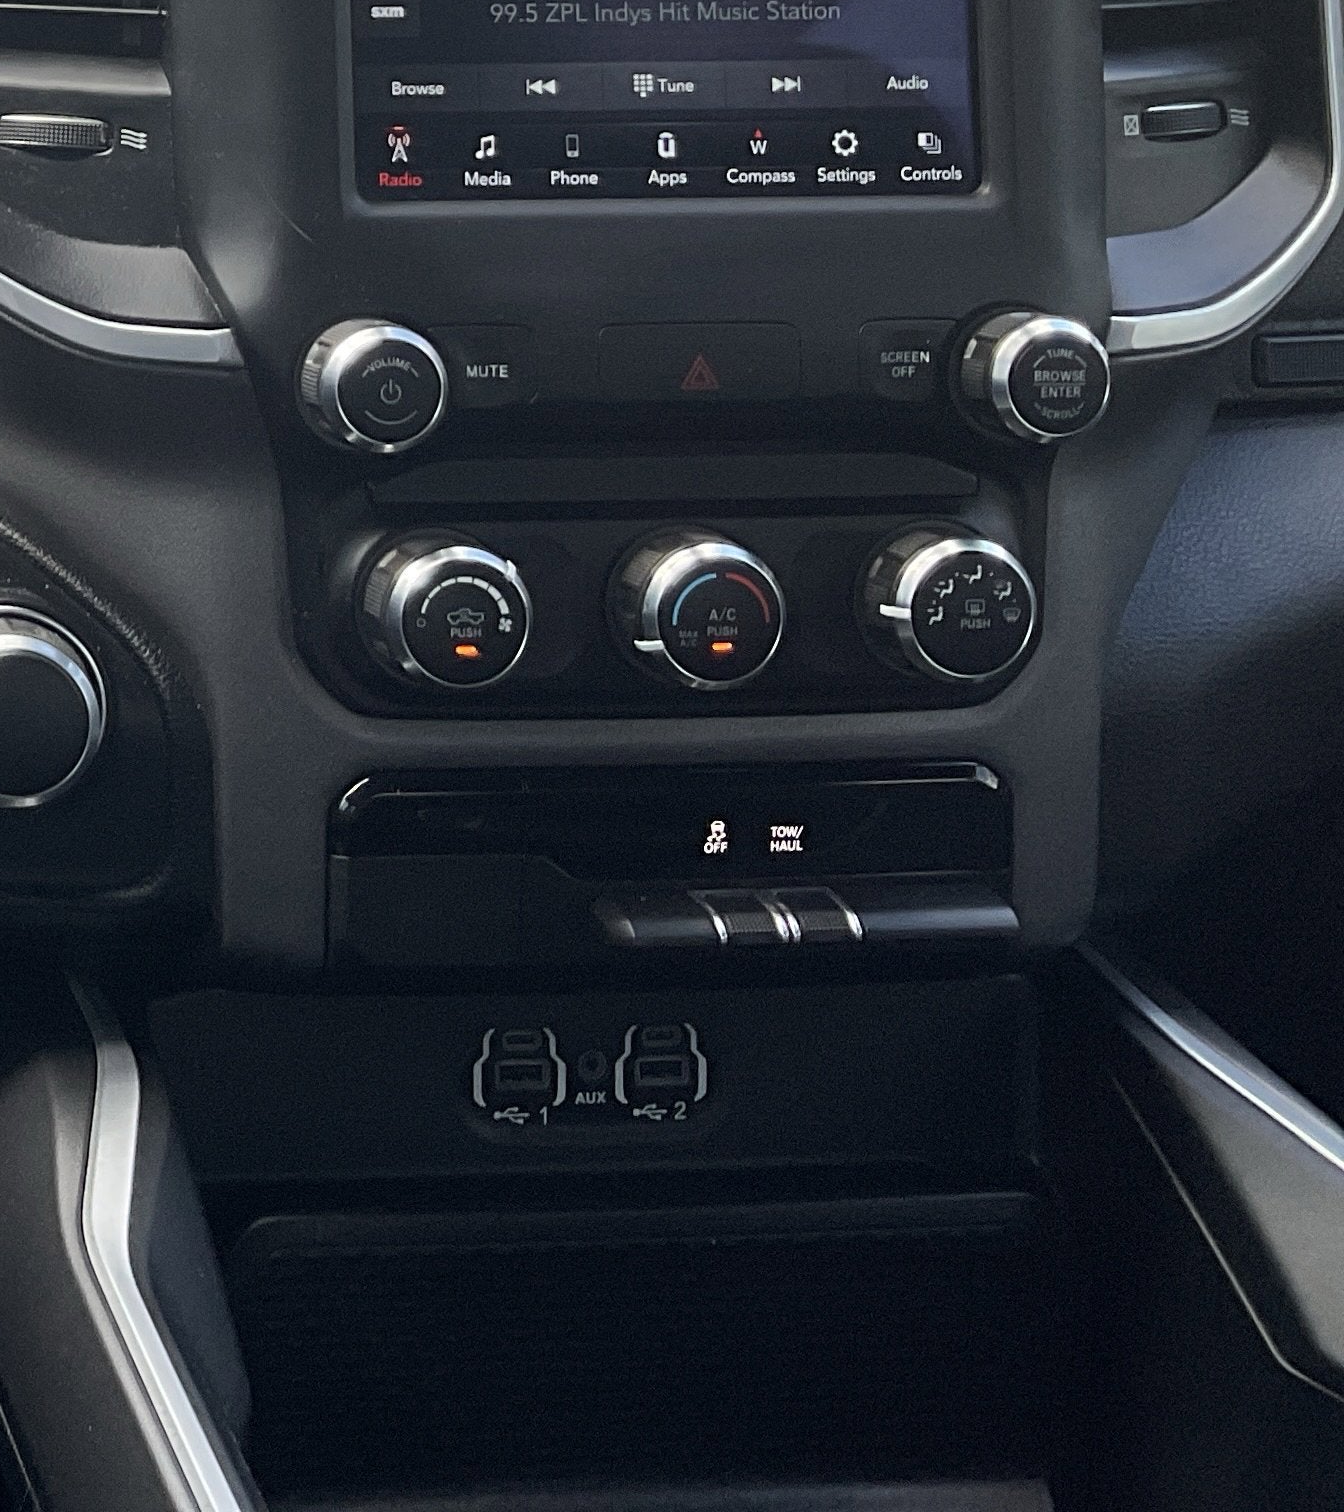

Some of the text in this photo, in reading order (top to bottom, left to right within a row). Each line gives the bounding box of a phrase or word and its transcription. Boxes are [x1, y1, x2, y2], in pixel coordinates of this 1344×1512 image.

[490, 0, 841, 27] 99.5 ZPL Indys Hit Music Station
[391, 80, 445, 96] Browse
[657, 77, 695, 93] Tune
[886, 75, 929, 90] Audio
[749, 139, 768, 155] W
[378, 171, 423, 187] Radio
[464, 170, 512, 187] Media
[550, 170, 599, 186] Phone
[648, 169, 687, 187] Apps
[726, 167, 796, 185] Compass
[816, 166, 876, 185] Settings
[900, 165, 963, 183] Controls
[880, 350, 931, 364] SCREEN
[1046, 348, 1075, 360] TUNE
[367, 356, 412, 372] VOLUME
[465, 364, 509, 378] MUTE
[891, 365, 917, 379] OFF
[1033, 369, 1087, 383] BROWSE
[1040, 385, 1082, 399] ENTER
[1041, 407, 1081, 420] SCROLL
[709, 607, 737, 621] A/C
[706, 625, 738, 637] PUSH
[960, 618, 991, 630] PUSH
[450, 627, 482, 638] PUSH
[770, 826, 804, 839] TOW/
[703, 841, 729, 854] OFF
[770, 840, 804, 853] HAUL
[575, 1091, 607, 1105] AUX
[539, 1106, 549, 1126] 1
[673, 1100, 688, 1120] 2
